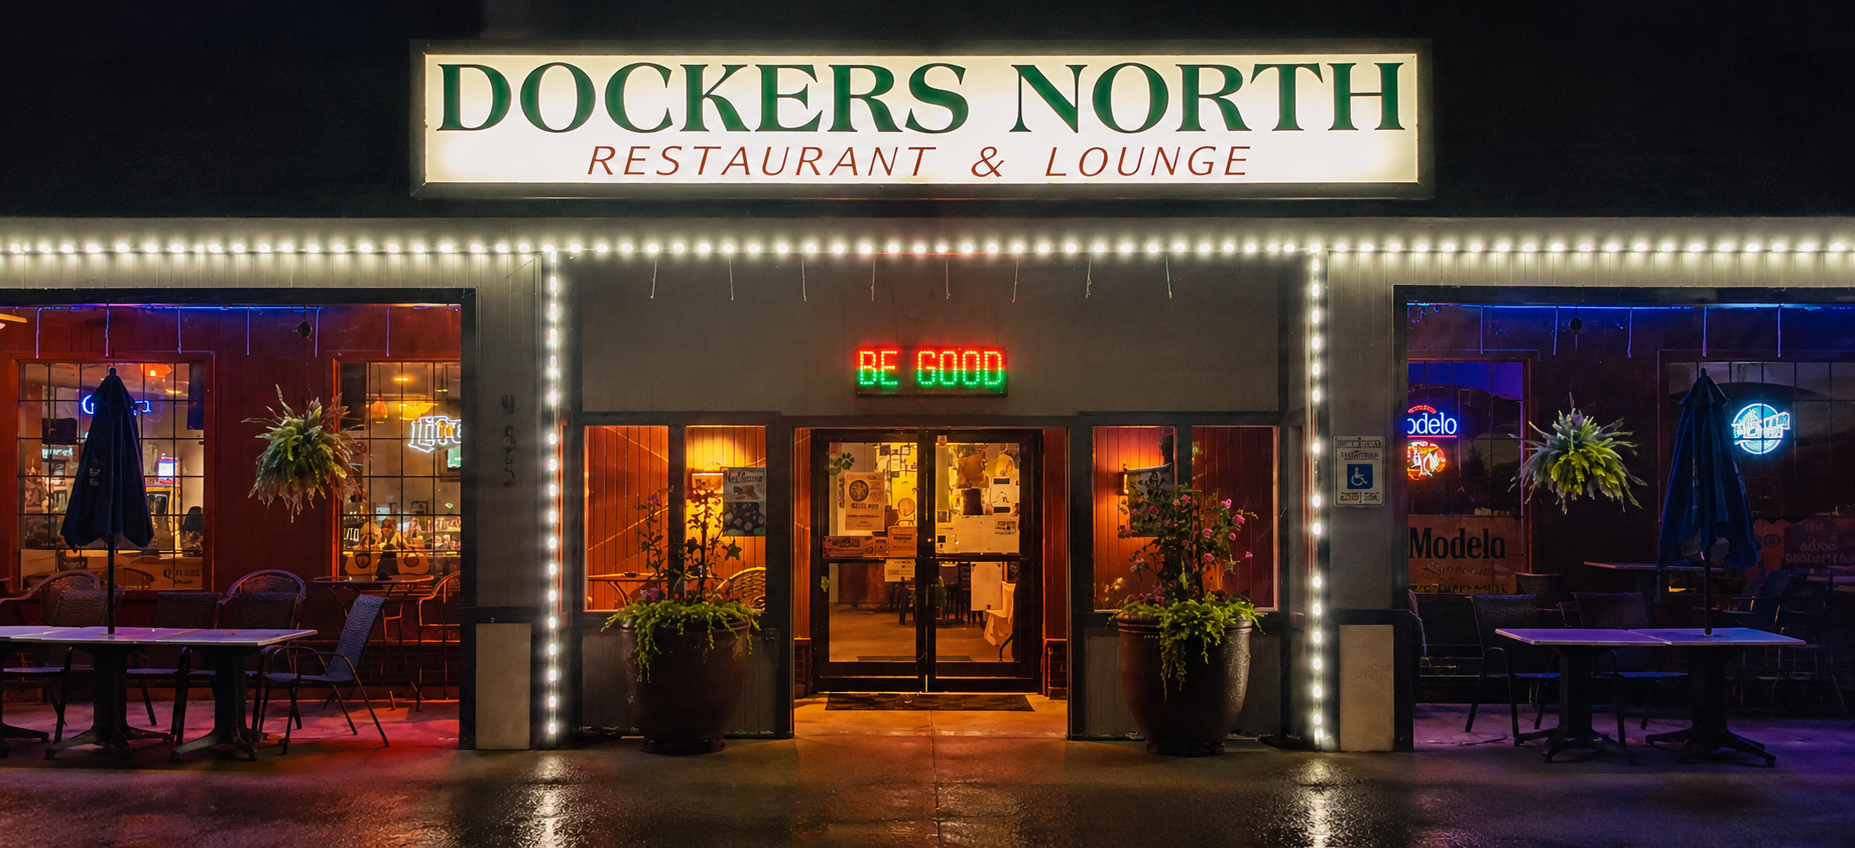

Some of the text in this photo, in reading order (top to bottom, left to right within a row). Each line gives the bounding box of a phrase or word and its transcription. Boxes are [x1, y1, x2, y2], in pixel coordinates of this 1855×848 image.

[437, 62, 1405, 132] DOCKERS NORTH
[587, 145, 1251, 179] RESTAURANT & LOUNGE
[859, 350, 1003, 386] BE GOOD
[1407, 412, 1457, 434] odelo
